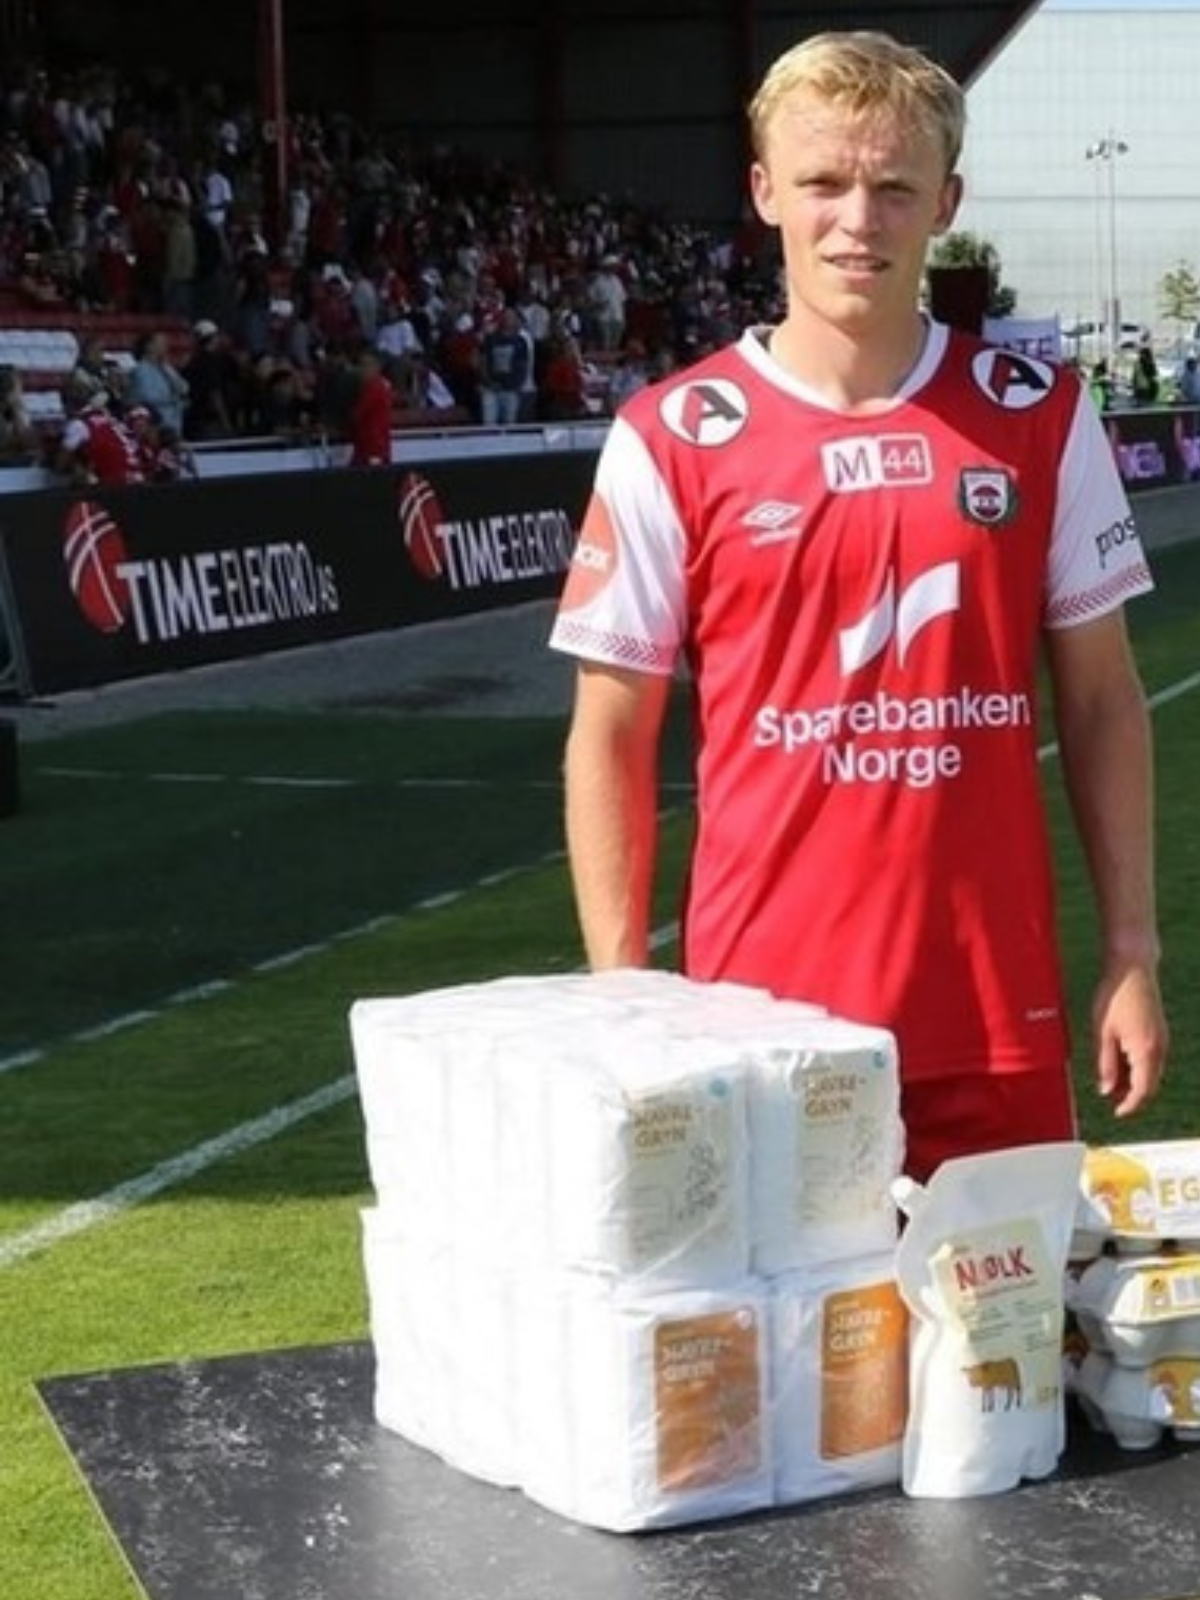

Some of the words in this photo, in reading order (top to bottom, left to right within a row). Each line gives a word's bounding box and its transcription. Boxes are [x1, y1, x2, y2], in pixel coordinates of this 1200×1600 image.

[832, 445, 872, 487] M
[882, 446, 922, 473] 44
[753, 686, 1031, 753] Sparebanken
[823, 742, 962, 788] Norge
